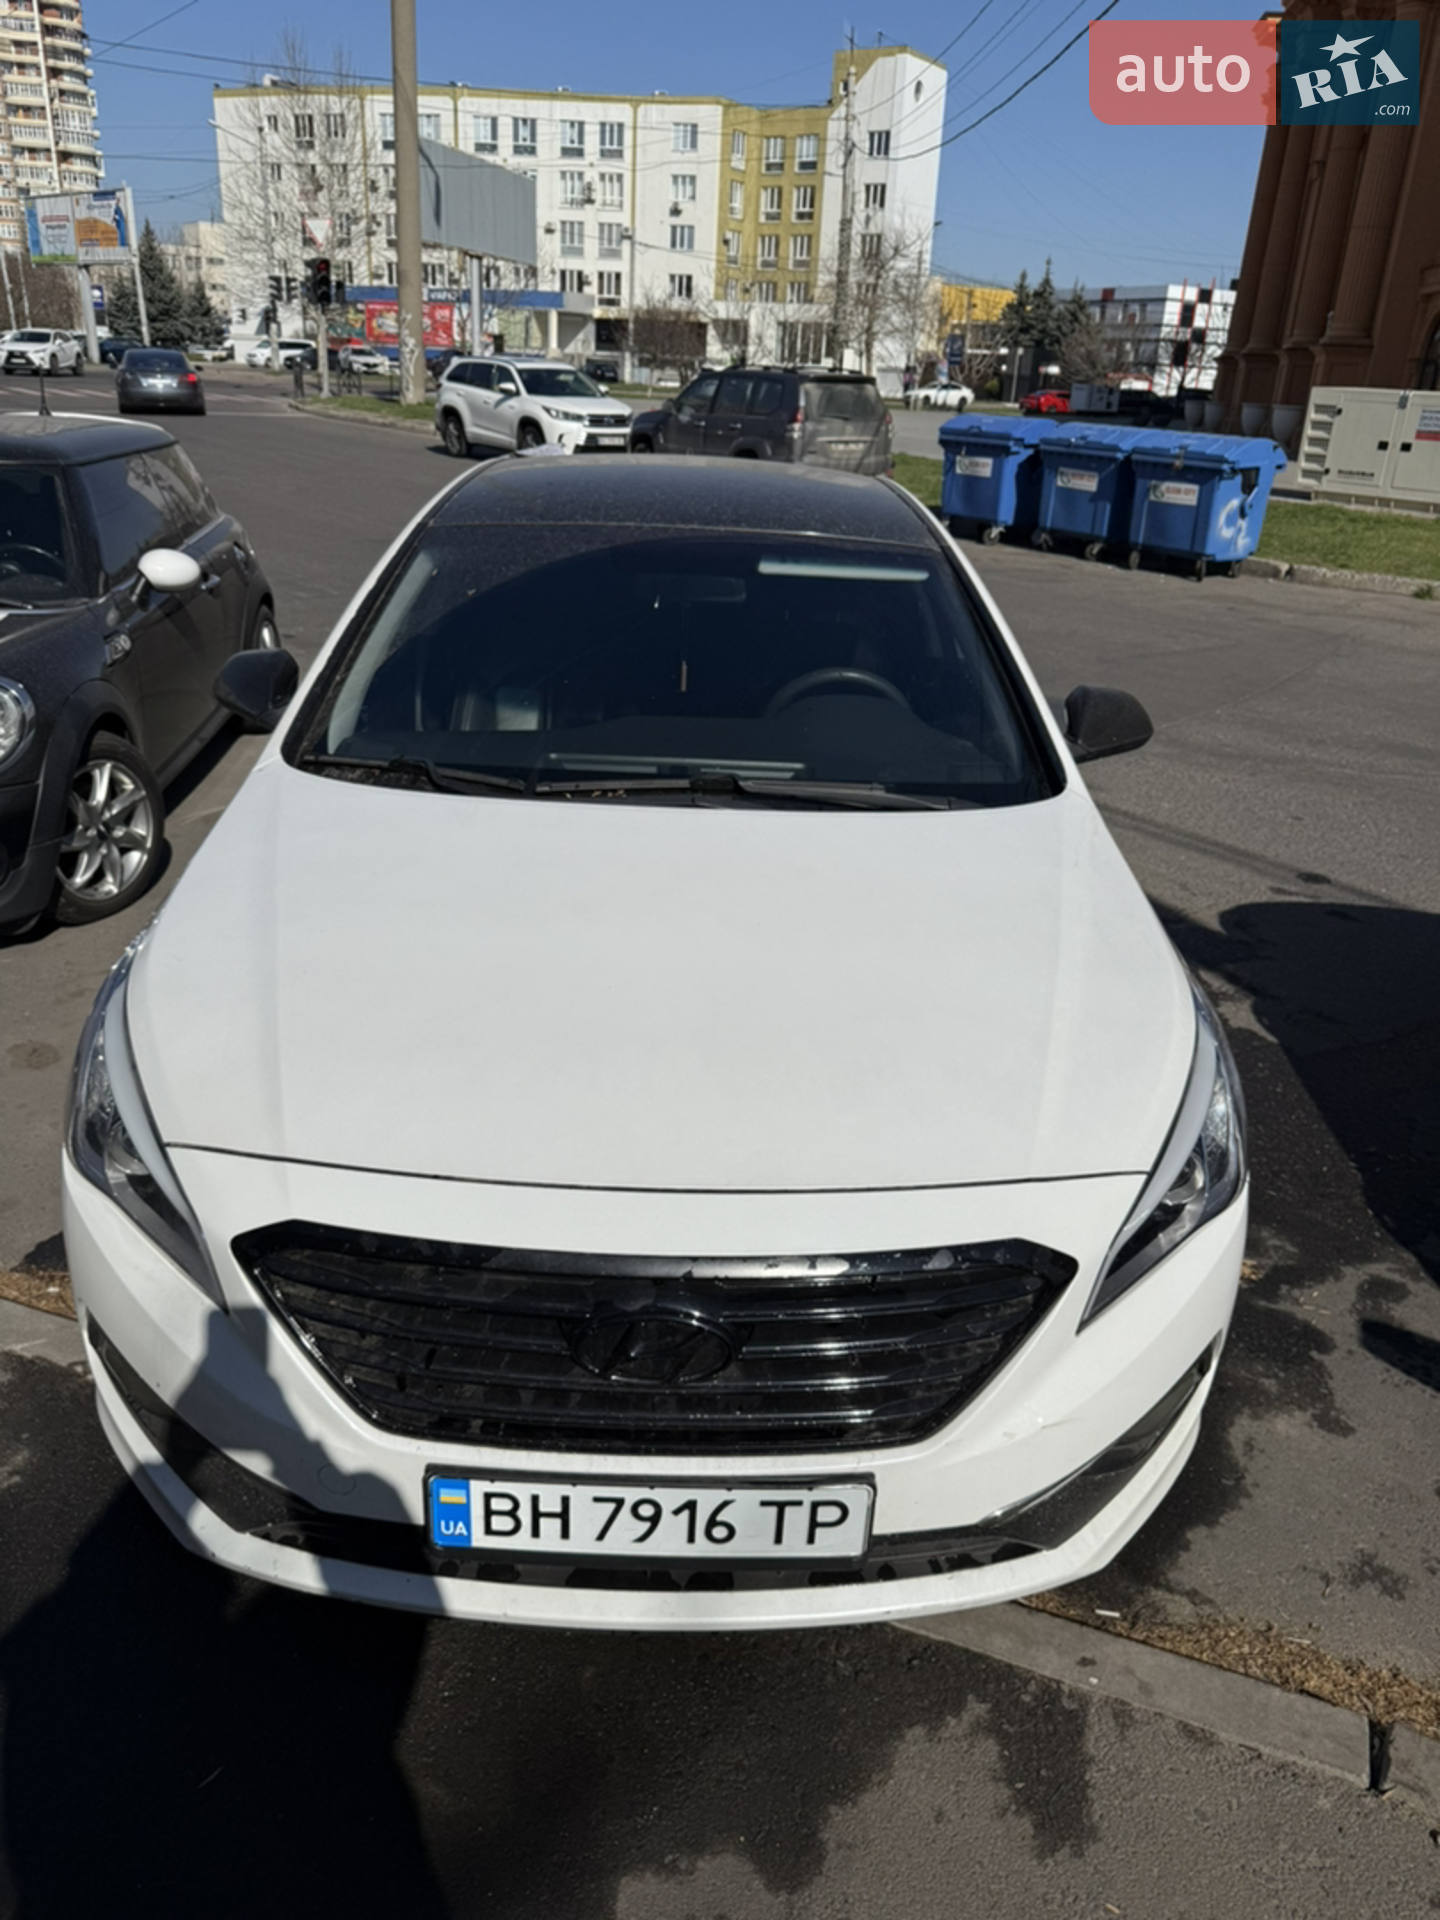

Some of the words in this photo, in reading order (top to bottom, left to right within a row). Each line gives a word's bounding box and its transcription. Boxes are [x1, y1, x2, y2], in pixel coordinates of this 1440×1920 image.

[440, 1519, 468, 1538] UA
[483, 1491, 571, 1541] BH
[592, 1496, 737, 1545] 7916
[760, 1499, 850, 1546] TP
